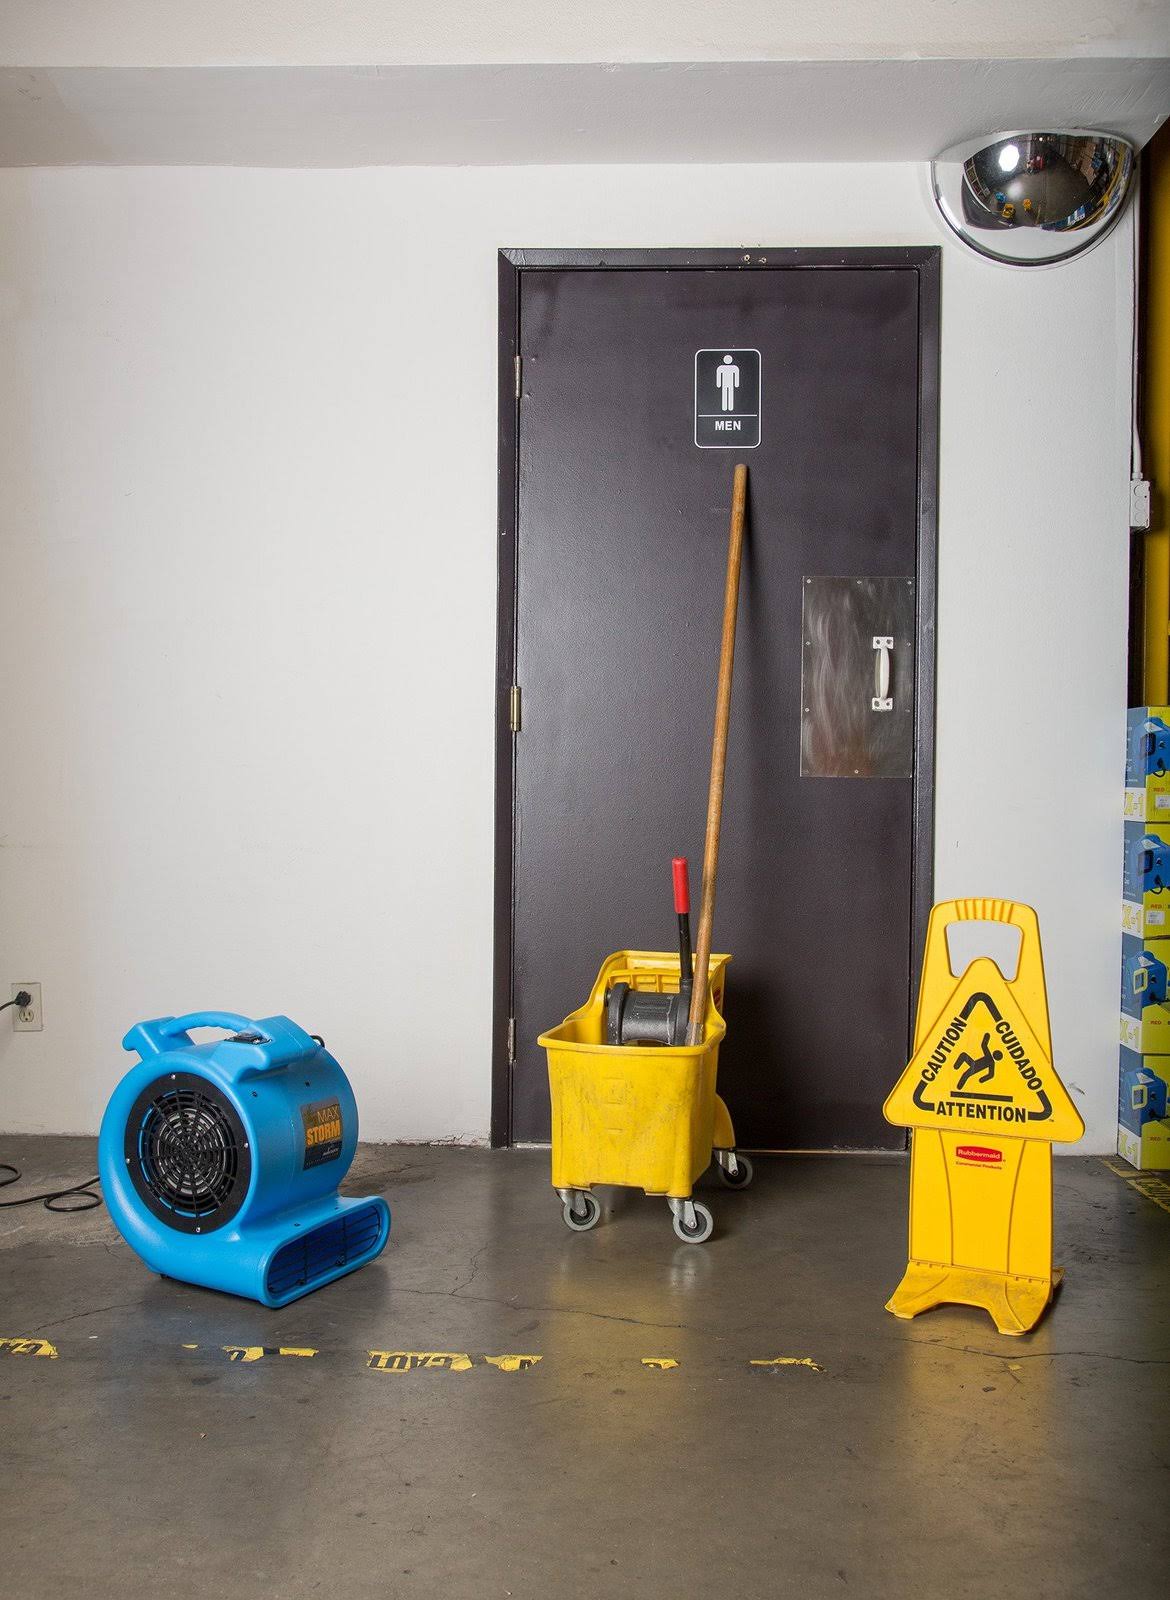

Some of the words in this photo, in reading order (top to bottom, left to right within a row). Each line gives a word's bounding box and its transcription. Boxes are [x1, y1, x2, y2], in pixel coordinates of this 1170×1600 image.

[715, 420, 741, 430] MEN
[921, 1016, 968, 1082] CAUTION
[995, 1021, 1043, 1091] CUIDADO
[317, 1105, 339, 1125] MAX
[936, 1101, 1026, 1123] ATTENTION
[306, 1119, 340, 1146] STORM
[957, 1148, 1001, 1160] Rubbermaid
